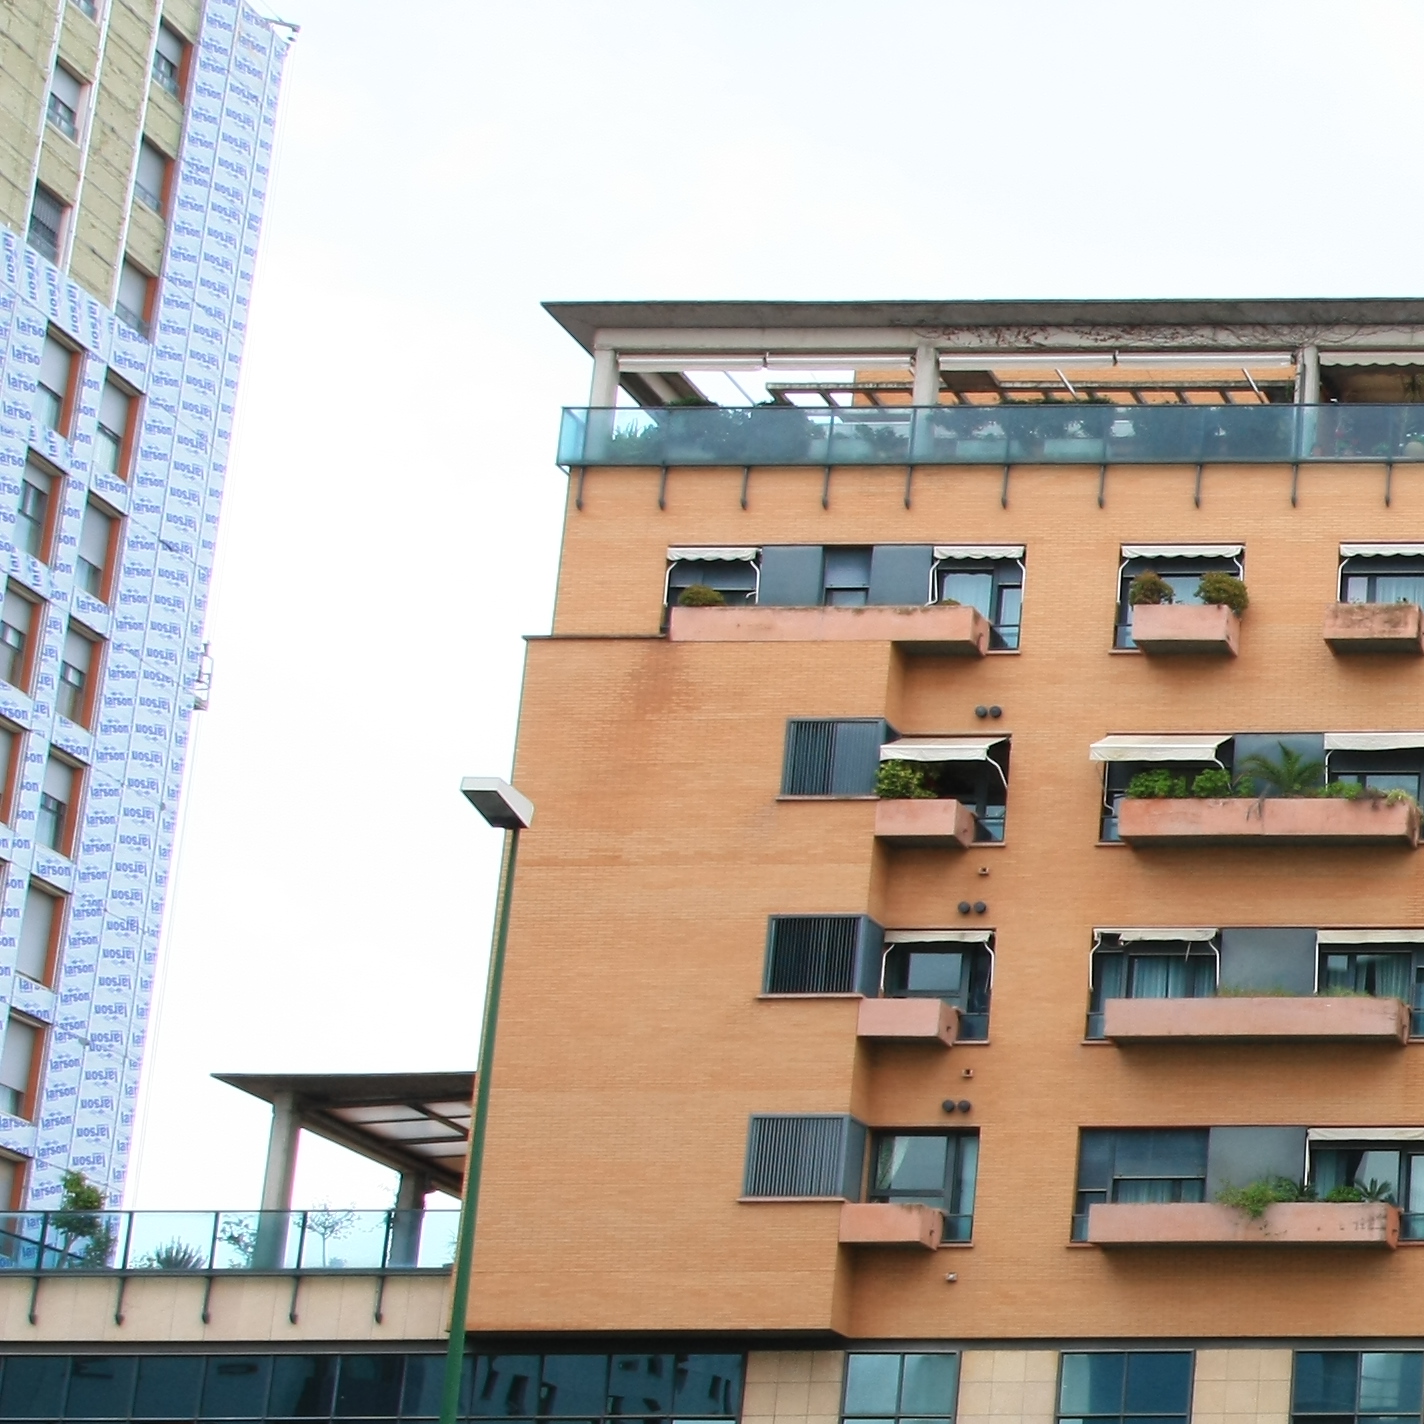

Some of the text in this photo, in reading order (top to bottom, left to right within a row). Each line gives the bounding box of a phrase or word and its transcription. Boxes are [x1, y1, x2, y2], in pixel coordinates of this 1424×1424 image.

[182, 173, 208, 186] larson
[178, 198, 204, 211] larson
[211, 202, 240, 223] larson
[174, 223, 201, 236] larson
[208, 228, 236, 246] larson
[170, 248, 198, 262] larson
[204, 253, 232, 270] larson
[200, 277, 228, 295] larson
[162, 297, 190, 310] larson
[17, 321, 44, 337] larso
[159, 323, 186, 335] larson
[193, 325, 222, 341] larson
[118, 327, 150, 345] larson
[12, 348, 40, 365] larso
[155, 348, 183, 361] larson
[190, 351, 218, 365] larson
[114, 354, 146, 372] larson
[8, 376, 36, 393] larso
[152, 375, 179, 387] larson
[186, 376, 215, 390] larson
[4, 404, 31, 420] larso
[182, 401, 211, 416] larson
[145, 423, 172, 435] larson
[178, 435, 207, 450] larson
[0, 452, 24, 466] arso
[141, 449, 168, 461] larson
[174, 461, 203, 476] larson
[95, 479, 127, 495] larson
[136, 476, 164, 486] larson
[170, 487, 200, 502] larson
[132, 501, 160, 514] larson
[167, 514, 196, 529] larson
[127, 537, 156, 549] larson
[123, 566, 152, 577] larson
[158, 568, 188, 583] larson
[119, 593, 148, 605] larson
[154, 595, 184, 609] larson
[77, 598, 110, 613] larson
[115, 620, 144, 631] larson
[150, 621, 181, 635] larson
[146, 648, 177, 661] larson
[108, 668, 137, 679] larson
[104, 696, 133, 706] larson
[139, 698, 170, 711] larson
[100, 723, 128, 734] larson
[136, 725, 166, 737] larson
[96, 750, 125, 761] larson
[132, 751, 162, 763] larson
[128, 779, 159, 790] larson
[91, 787, 120, 798] larson
[124, 807, 154, 818] larson
[86, 814, 115, 824] larson
[120, 835, 150, 846] larson
[82, 842, 111, 853] larson
[37, 862, 71, 877] larson
[116, 862, 146, 874] larson
[78, 870, 107, 881] larson
[111, 890, 142, 900] larson
[72, 906, 102, 917] larson
[107, 919, 138, 930] larson
[69, 935, 98, 946] larson
[103, 948, 134, 958] larson
[64, 962, 94, 974] larson
[99, 976, 131, 986] larson
[60, 991, 90, 1003] larson
[94, 1004, 126, 1014] larson
[90, 1032, 122, 1043] larson
[50, 1058, 80, 1070] larson
[85, 1070, 117, 1080] larson
[46, 1086, 76, 1099] larson
[81, 1098, 113, 1108] larson
[42, 1116, 71, 1129] larson
[77, 1127, 109, 1136] larson
[37, 1144, 67, 1157] larson
[72, 1155, 105, 1165] larson
[31, 1185, 62, 1198] larson
